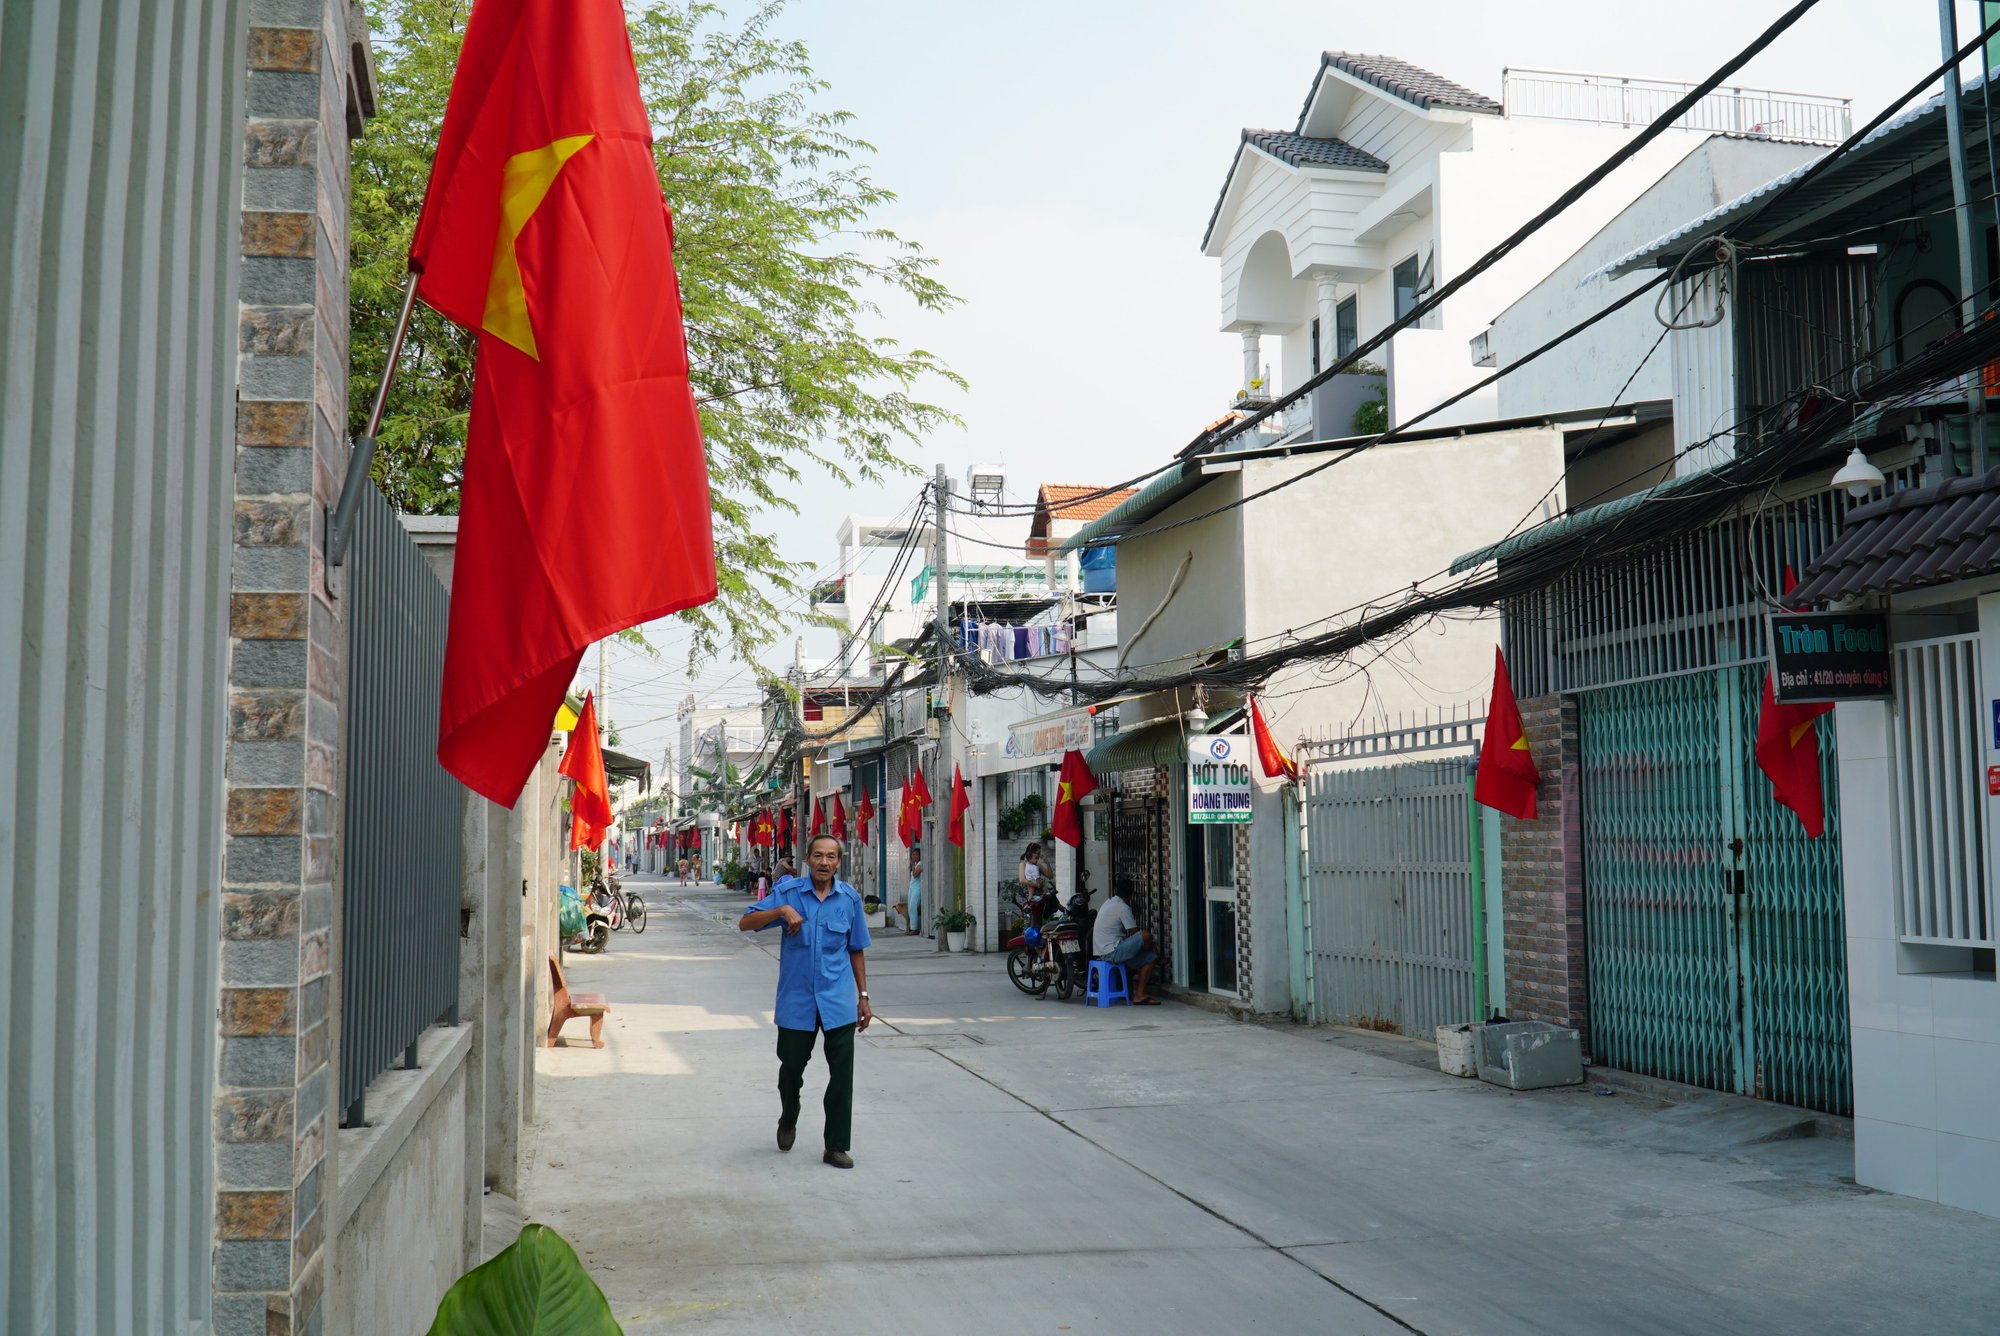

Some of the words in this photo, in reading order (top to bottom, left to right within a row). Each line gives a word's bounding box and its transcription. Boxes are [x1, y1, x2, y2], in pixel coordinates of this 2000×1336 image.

[1779, 624, 1829, 654] Tròn
[1833, 623, 1885, 653] Food
[1781, 671, 1795, 690] Địa
[1193, 759, 1219, 786] HỚT
[1222, 760, 1249, 786] TÓC
[1192, 790, 1221, 809] HOÀNG
[1223, 792, 1250, 809] TRUNG
